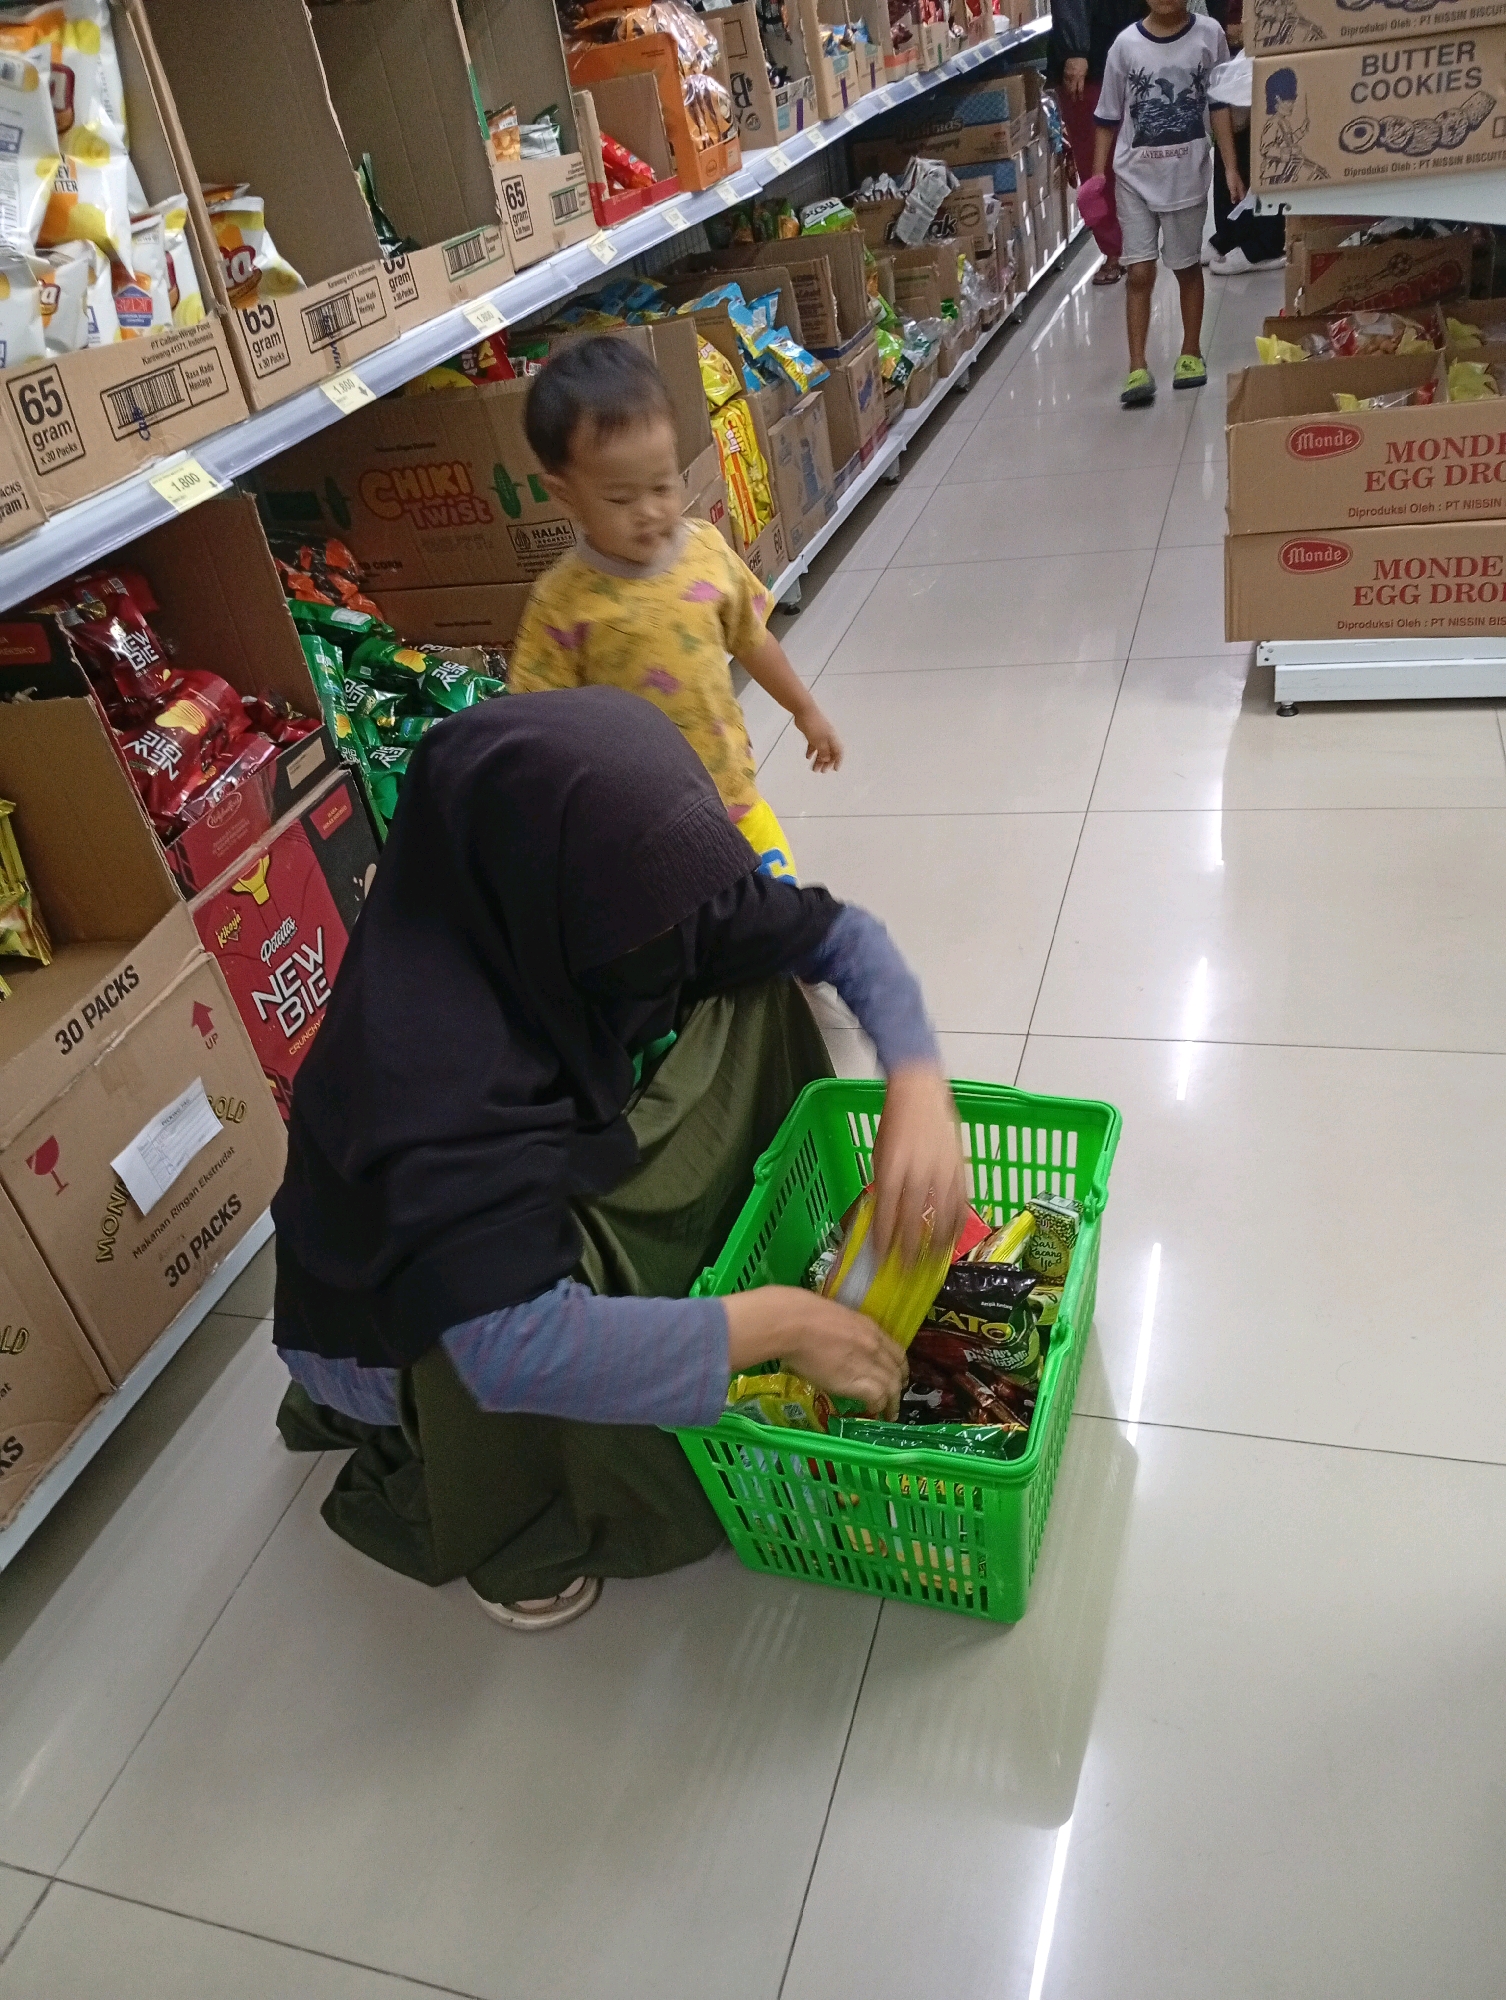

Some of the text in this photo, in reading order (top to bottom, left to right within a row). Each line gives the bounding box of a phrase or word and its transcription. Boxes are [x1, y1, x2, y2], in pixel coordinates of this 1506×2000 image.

[1361, 39, 1478, 77] BUTTER
[1350, 66, 1483, 104] COOKIES
[505, 181, 525, 210] 65
[389, 272, 411, 293] gram
[252, 331, 282, 358] gram
[19, 376, 63, 426] 65
[32, 419, 73, 452] gram
[1296, 429, 1353, 452] Monde
[46, 449, 57, 464] 30
[57, 442, 78, 459] Packs
[171, 472, 201, 492] 1.800
[360, 461, 474, 521] CHIKI
[1365, 466, 1436, 493] EGG
[1348, 505, 1407, 520] Diproduksi
[1410, 502, 1435, 515] Oleh
[1445, 500, 1460, 511] PT
[1463, 497, 1502, 511] NISSIN
[531, 525, 570, 539] HALAL
[1288, 547, 1342, 566] Monde
[1372, 555, 1504, 581] MONDE
[1353, 582, 1421, 607] EGG
[1337, 619, 1394, 632] Diproduksi
[1397, 618, 1421, 628] Oleh
[1430, 618, 1444, 628] PT
[1448, 616, 1486, 627] NISSIN
[113, 629, 150, 661] NEW
[129, 644, 160, 672] BIE
[251, 927, 323, 1022] NEW
[54, 964, 140, 1056] 30 PACKS
[276, 967, 332, 1039] BIE
[205, 1033, 219, 1050] UP
[132, 1215, 171, 1259] Makanan
[170, 1185, 199, 1219] Ringan
[198, 1146, 236, 1190] Ekstrudat
[96, 1182, 130, 1263] MON
[164, 1254, 191, 1289] 30
[189, 1194, 243, 1260] PACKS
[1032, 1235, 1057, 1250] Sari
[1030, 1248, 1063, 1264] Kacang
